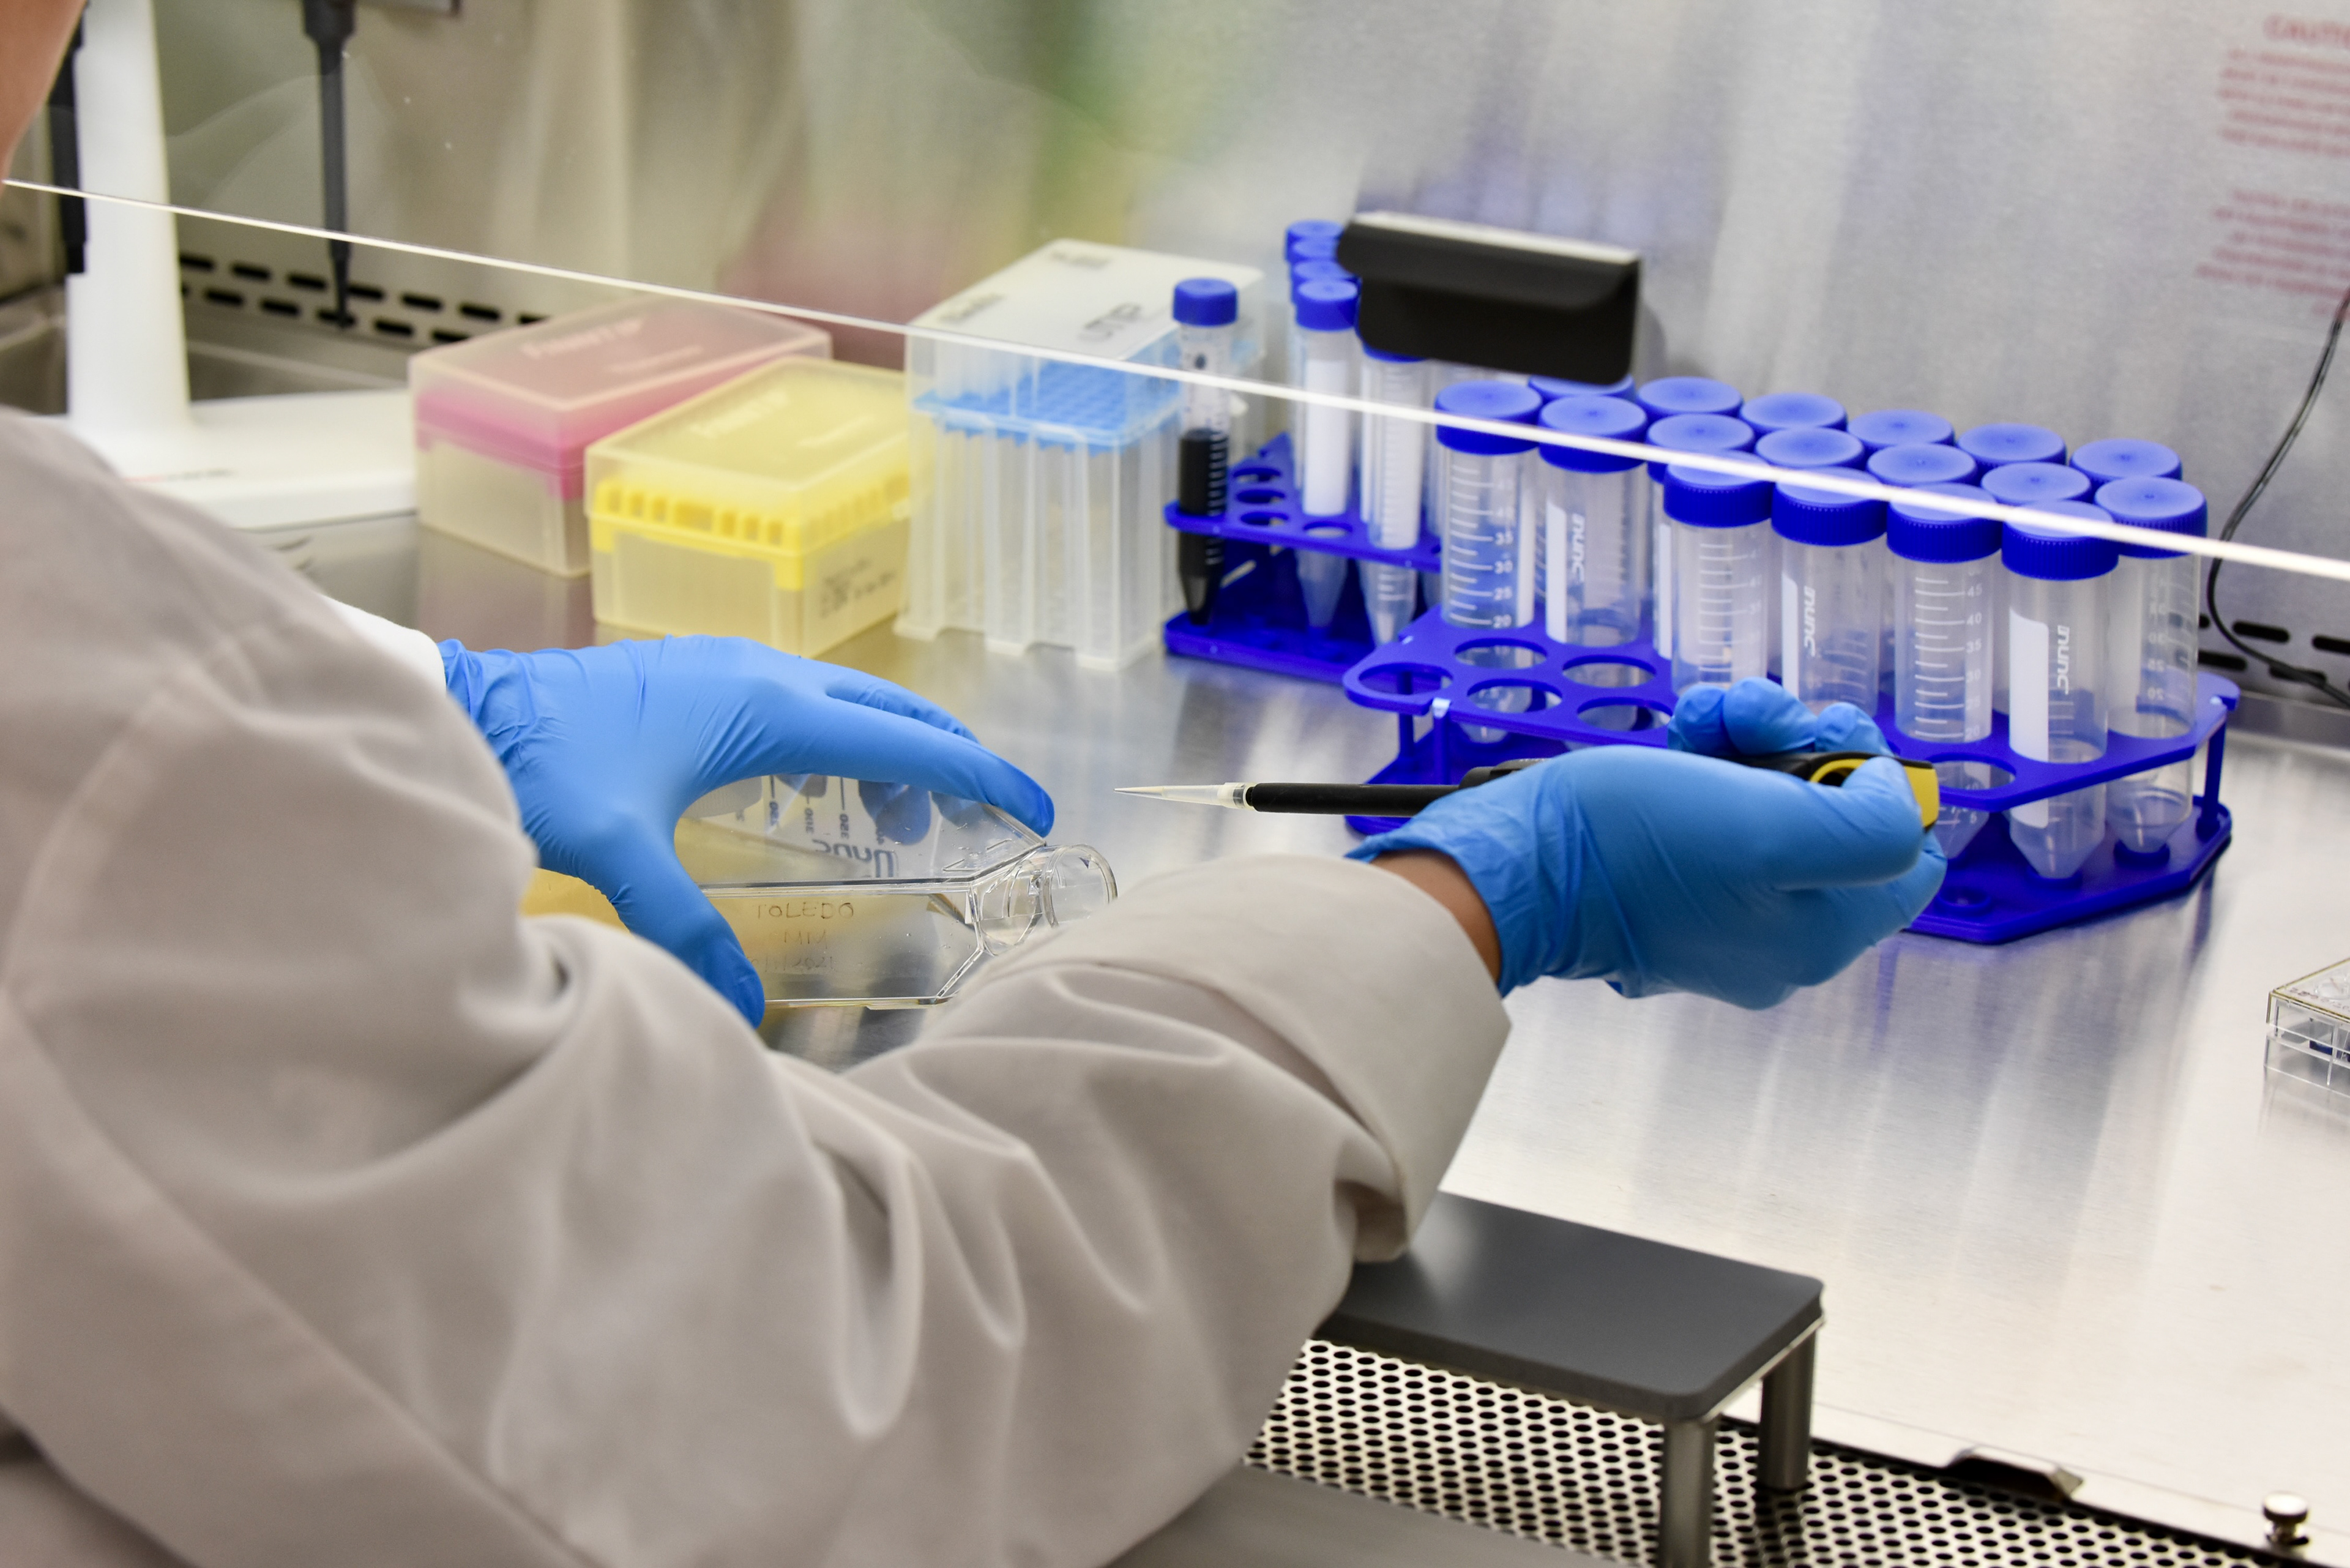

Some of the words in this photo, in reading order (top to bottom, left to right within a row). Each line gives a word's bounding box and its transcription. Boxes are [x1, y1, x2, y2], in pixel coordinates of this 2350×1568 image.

[1495, 530, 1513, 545] 35
[1572, 513, 1586, 583] nunc
[1494, 559, 1513, 574] 30
[1493, 586, 1513, 601] 25
[1967, 583, 1983, 597] 45
[1493, 614, 1512, 629] 20
[1804, 585, 1816, 657] nunc
[1966, 612, 1982, 626] 40
[1966, 638, 1982, 654] 35
[2057, 624, 2070, 696] nunc
[753, 902, 854, 919] TOLEDO
